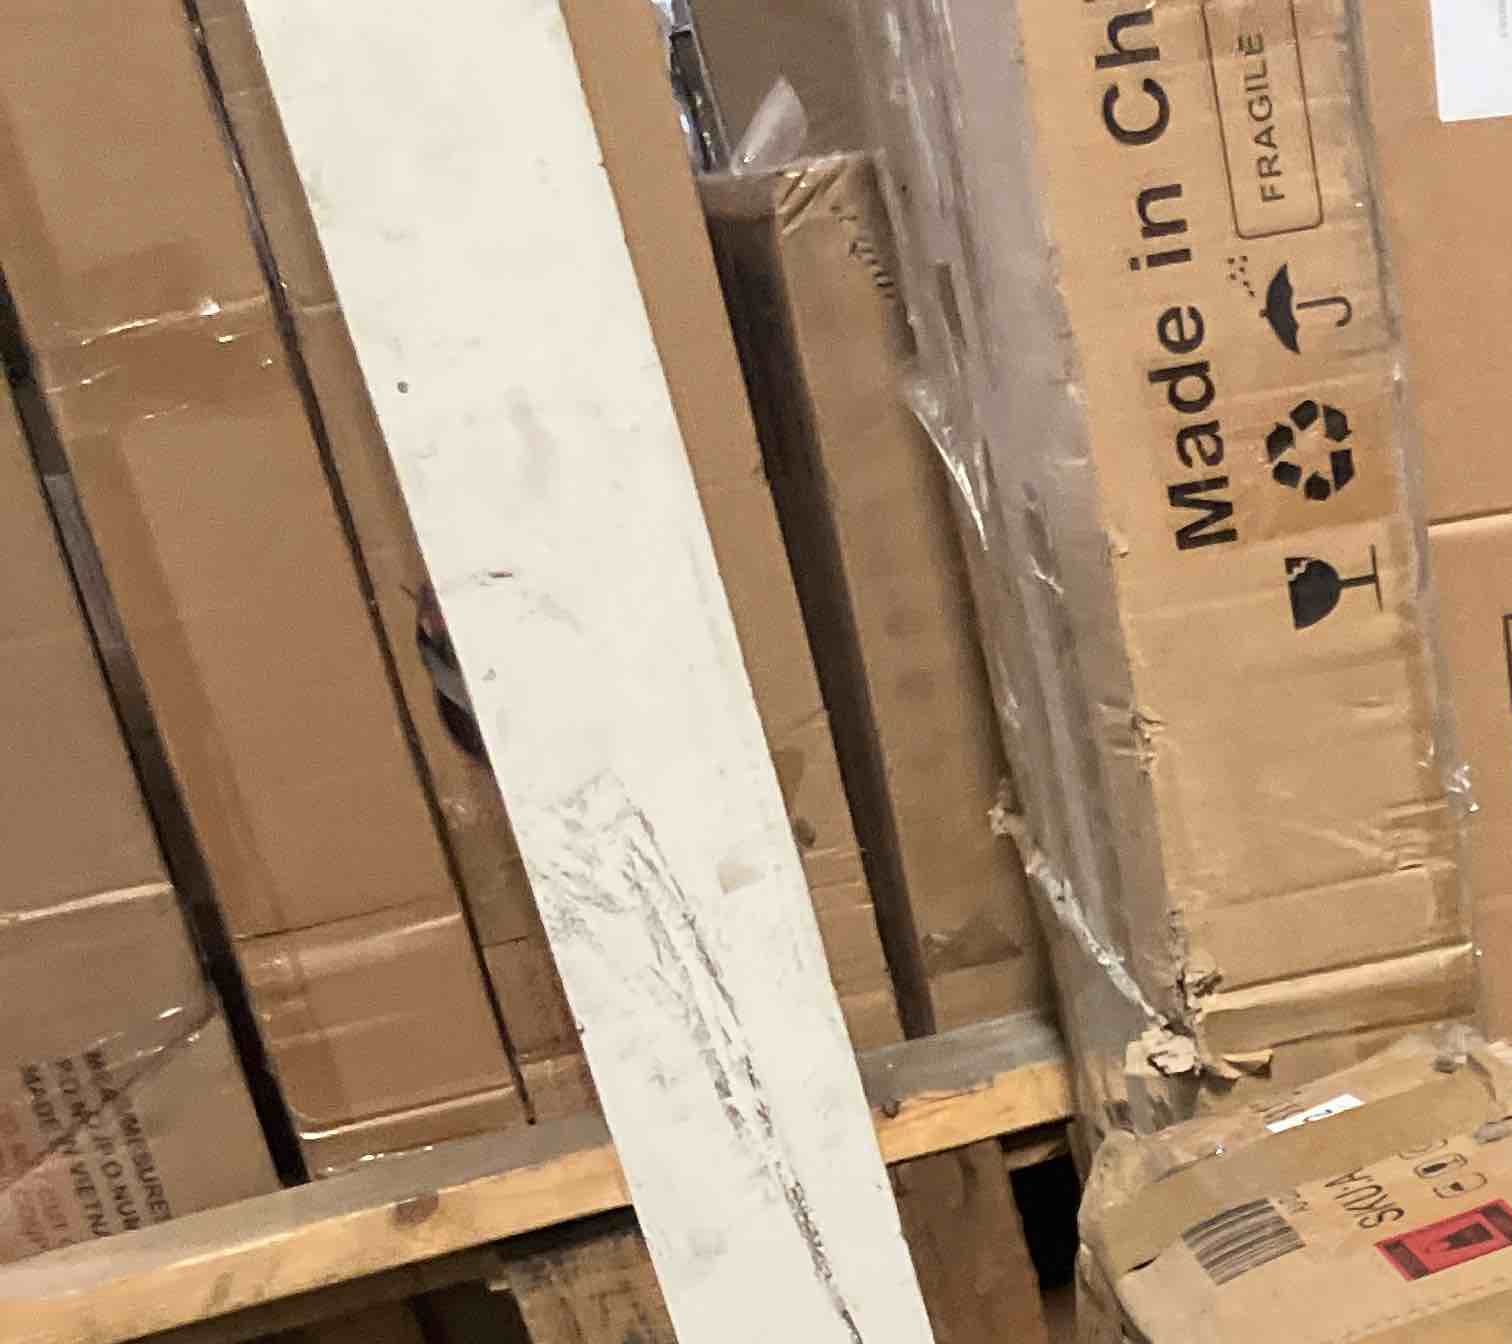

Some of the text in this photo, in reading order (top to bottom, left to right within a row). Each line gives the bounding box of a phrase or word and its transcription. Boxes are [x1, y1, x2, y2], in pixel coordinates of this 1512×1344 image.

[1086, 0, 1238, 551] Made in Ch
[1237, 31, 1285, 204] FRAGILE
